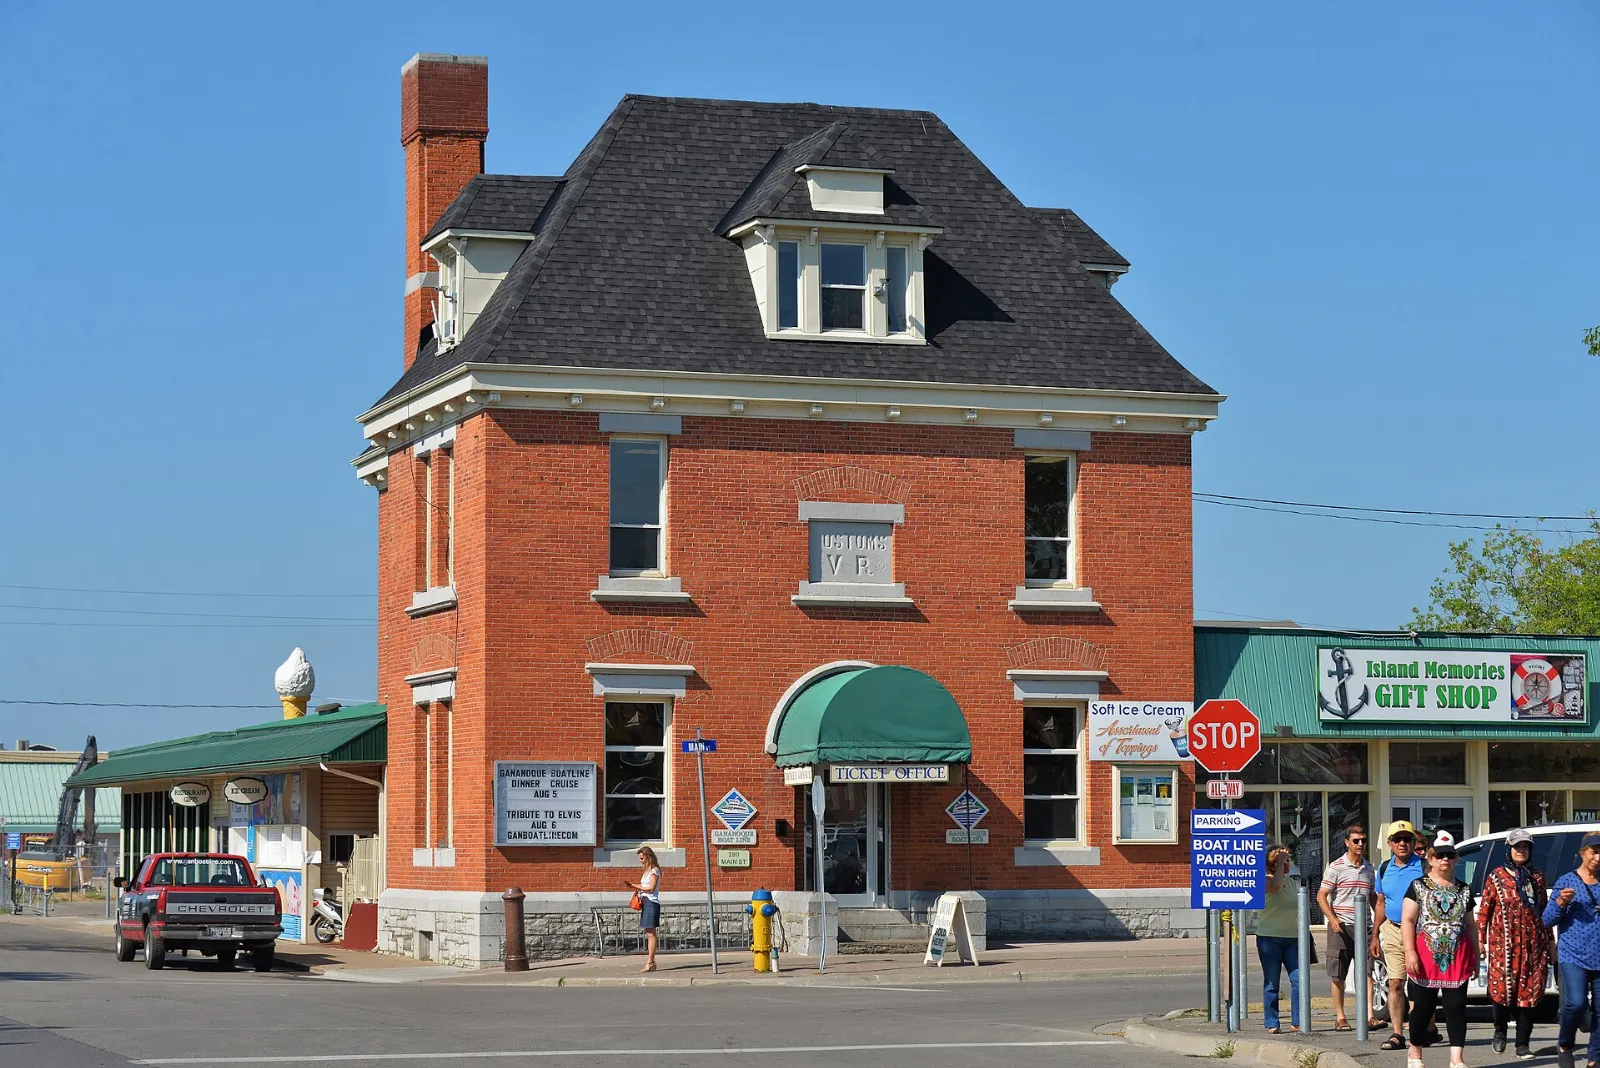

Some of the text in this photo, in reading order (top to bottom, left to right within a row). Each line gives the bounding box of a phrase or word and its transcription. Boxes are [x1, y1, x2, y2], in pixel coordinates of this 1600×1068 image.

[826, 553, 874, 576] V R
[1366, 660, 1505, 681] Island Memories
[1374, 683, 1498, 710] GIFT SHOP
[1092, 704, 1185, 716] Soft Ice Cream
[1096, 720, 1162, 737] Assortment
[1192, 722, 1255, 750] STOP
[688, 742, 705, 751] MAIN
[1099, 739, 1114, 756] of
[1115, 738, 1159, 759] Toppings
[500, 769, 590, 778] GANANOQUE BOATLINE
[836, 766, 946, 780] TICKET OFFICE
[512, 780, 579, 788] DINNER CRUISE
[1210, 782, 1241, 795] ALL-WAY
[534, 790, 558, 798] AUG 5
[506, 810, 582, 819] TRIBUTE TO ELVIS
[1574, 811, 1596, 822] ATM
[531, 821, 557, 829] AUG 6
[1196, 816, 1241, 825] PARKING
[1193, 840, 1263, 851] BOAT LINE
[1196, 854, 1256, 866] PARKING
[1199, 869, 1258, 877] TURN RIGHT
[1200, 879, 1256, 888] AT CORNER
[178, 905, 264, 913] CHEVROLET
[931, 938, 945, 947] HERE
